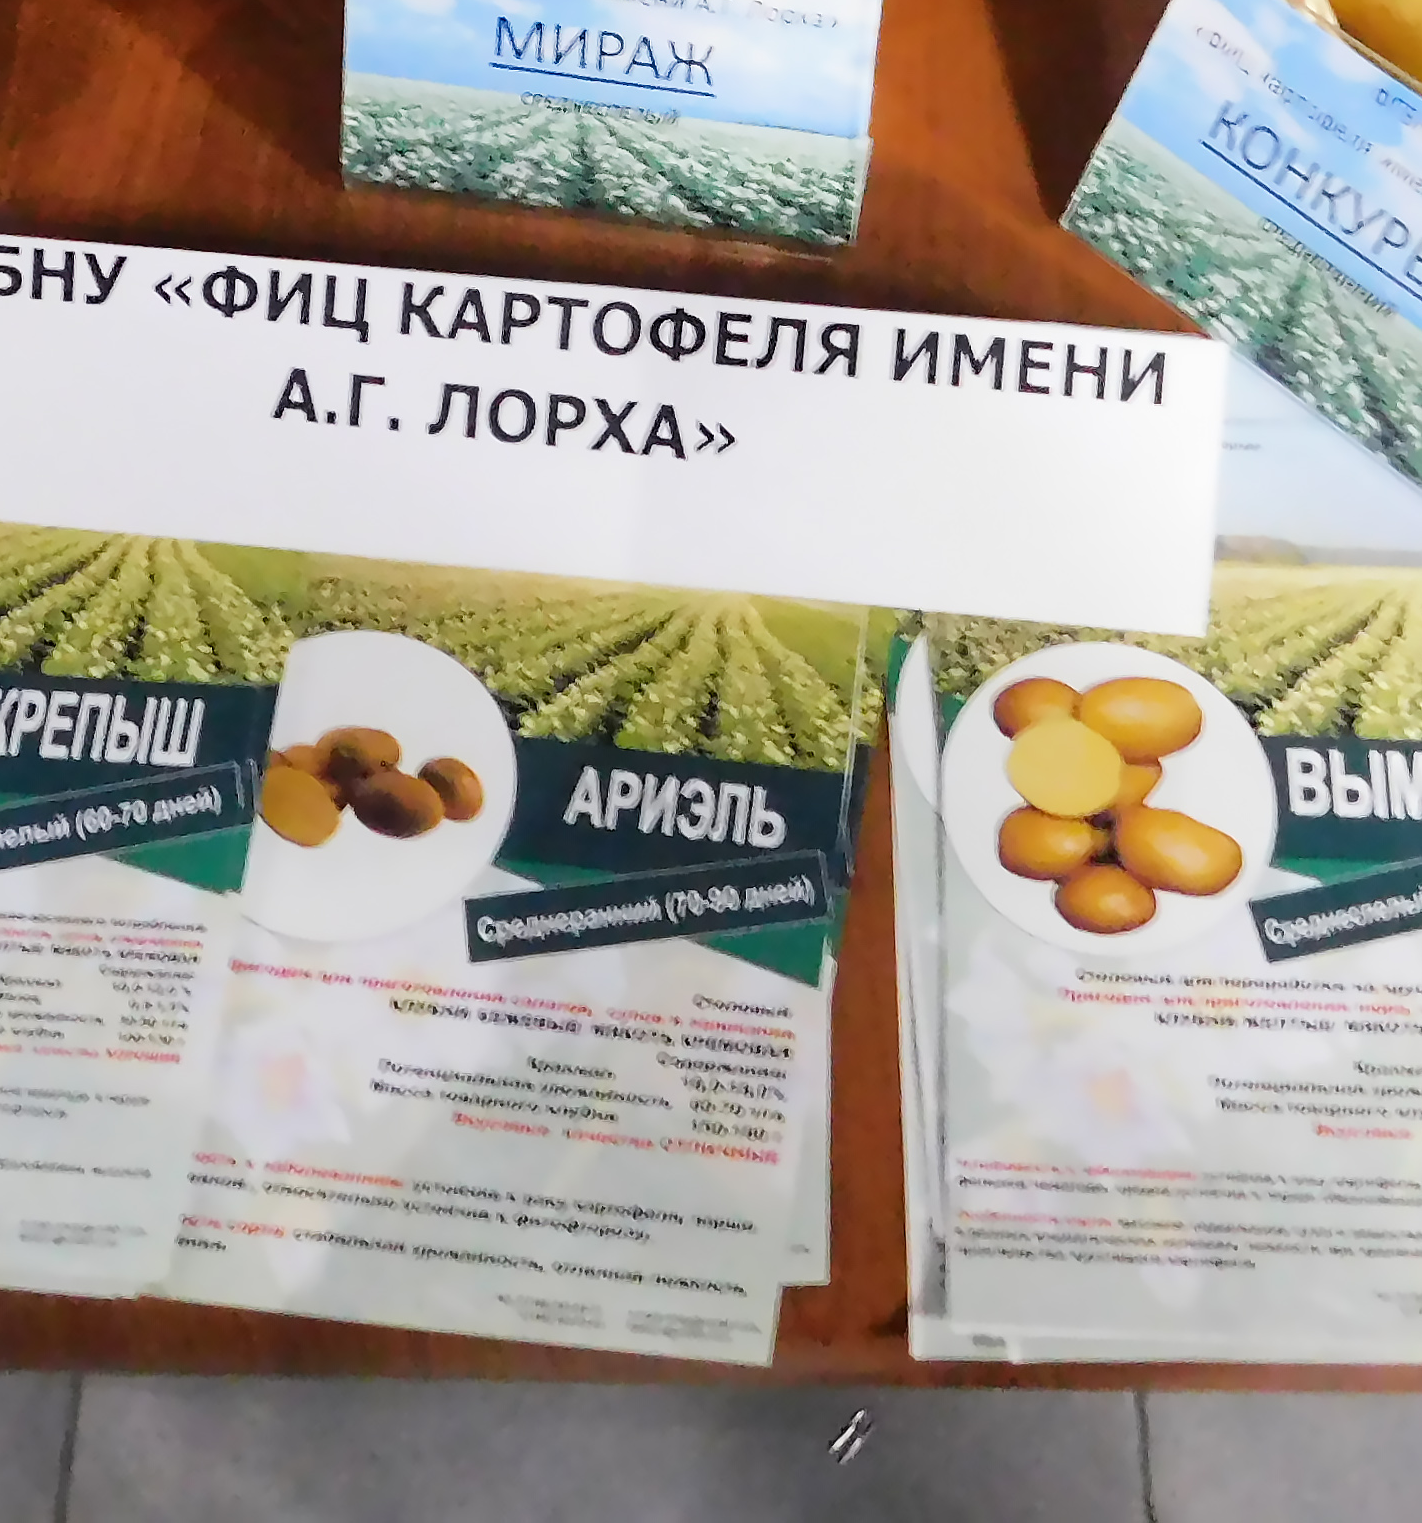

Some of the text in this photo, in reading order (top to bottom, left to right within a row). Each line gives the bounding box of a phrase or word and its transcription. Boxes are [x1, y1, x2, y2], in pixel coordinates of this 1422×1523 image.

[494, 15, 716, 87] МИРАЖ
[153, 264, 372, 344] «ФИЦ
[399, 289, 861, 377] КАРТОФЕЛЯ
[891, 327, 1167, 406] ИМЕНИ
[272, 367, 736, 461] А.Г. ЛОРХА»
[152, 784, 222, 824] дней)
[562, 765, 787, 849] АРИЭЛЬ
